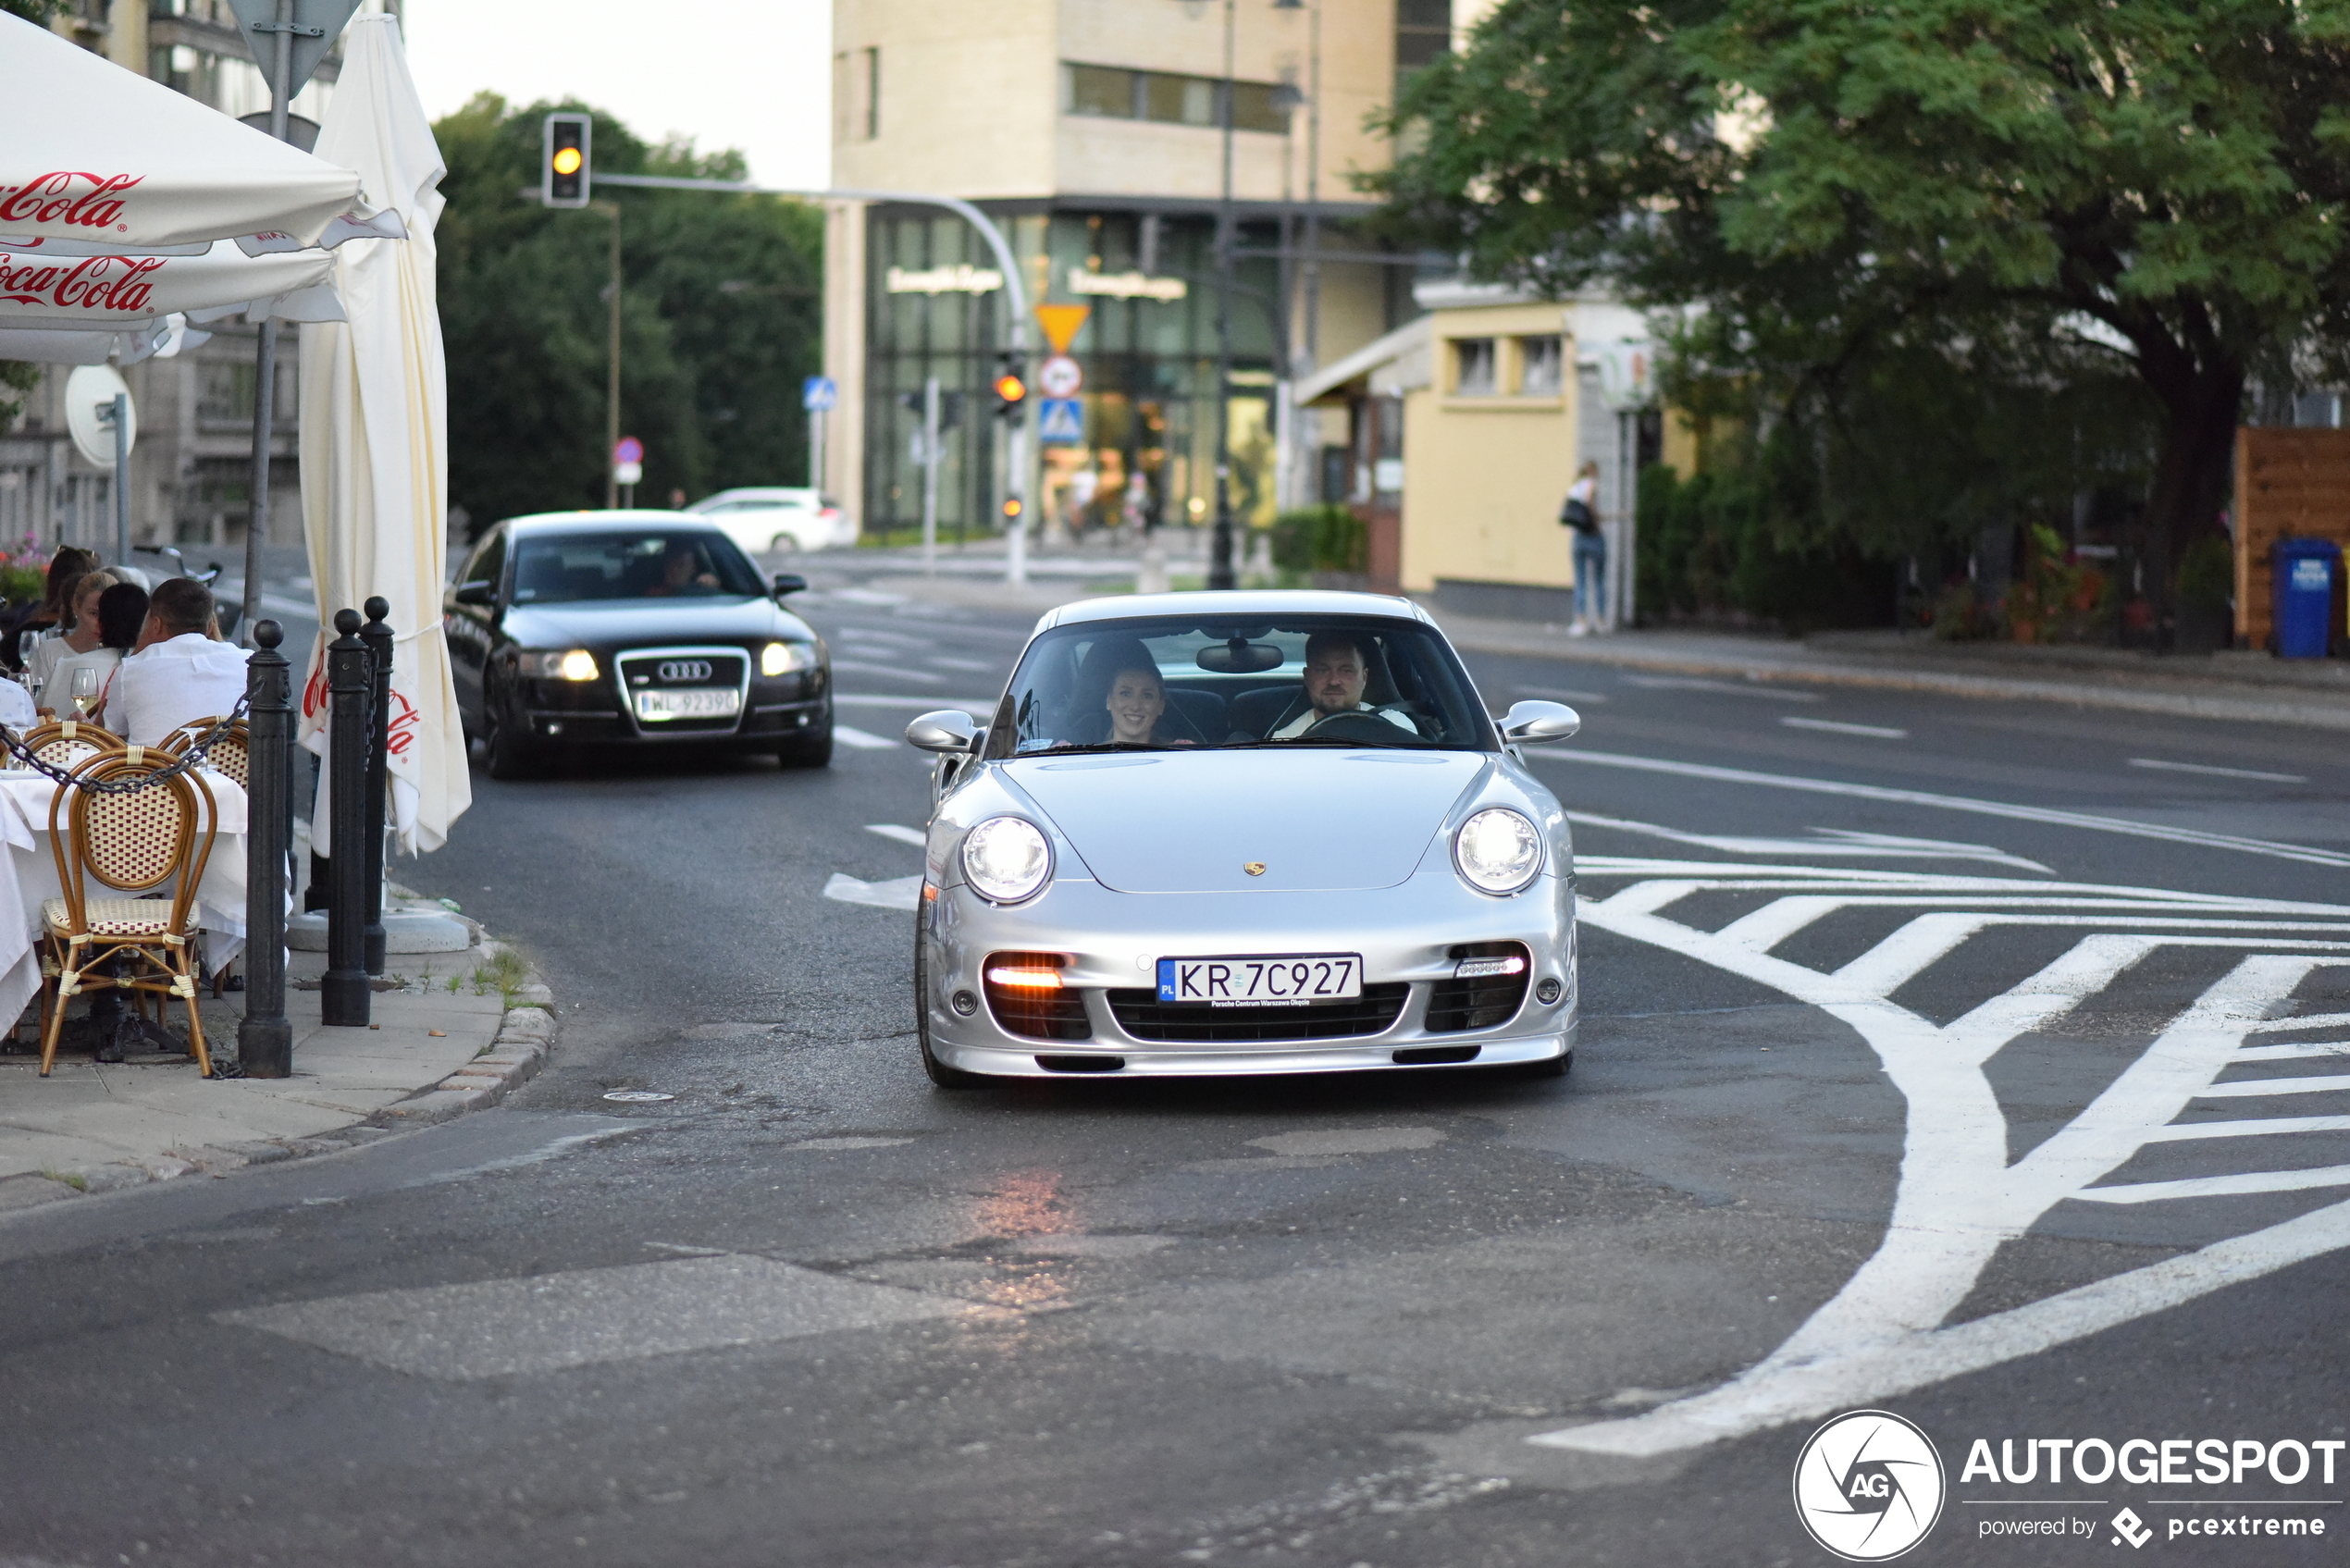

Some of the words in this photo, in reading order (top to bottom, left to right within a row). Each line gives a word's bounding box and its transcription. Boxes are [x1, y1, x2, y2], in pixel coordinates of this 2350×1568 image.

[652, 695, 675, 711] WL
[1181, 964, 1231, 997] KR
[1246, 960, 1353, 996] 7C927
[1161, 984, 1174, 995] PL
